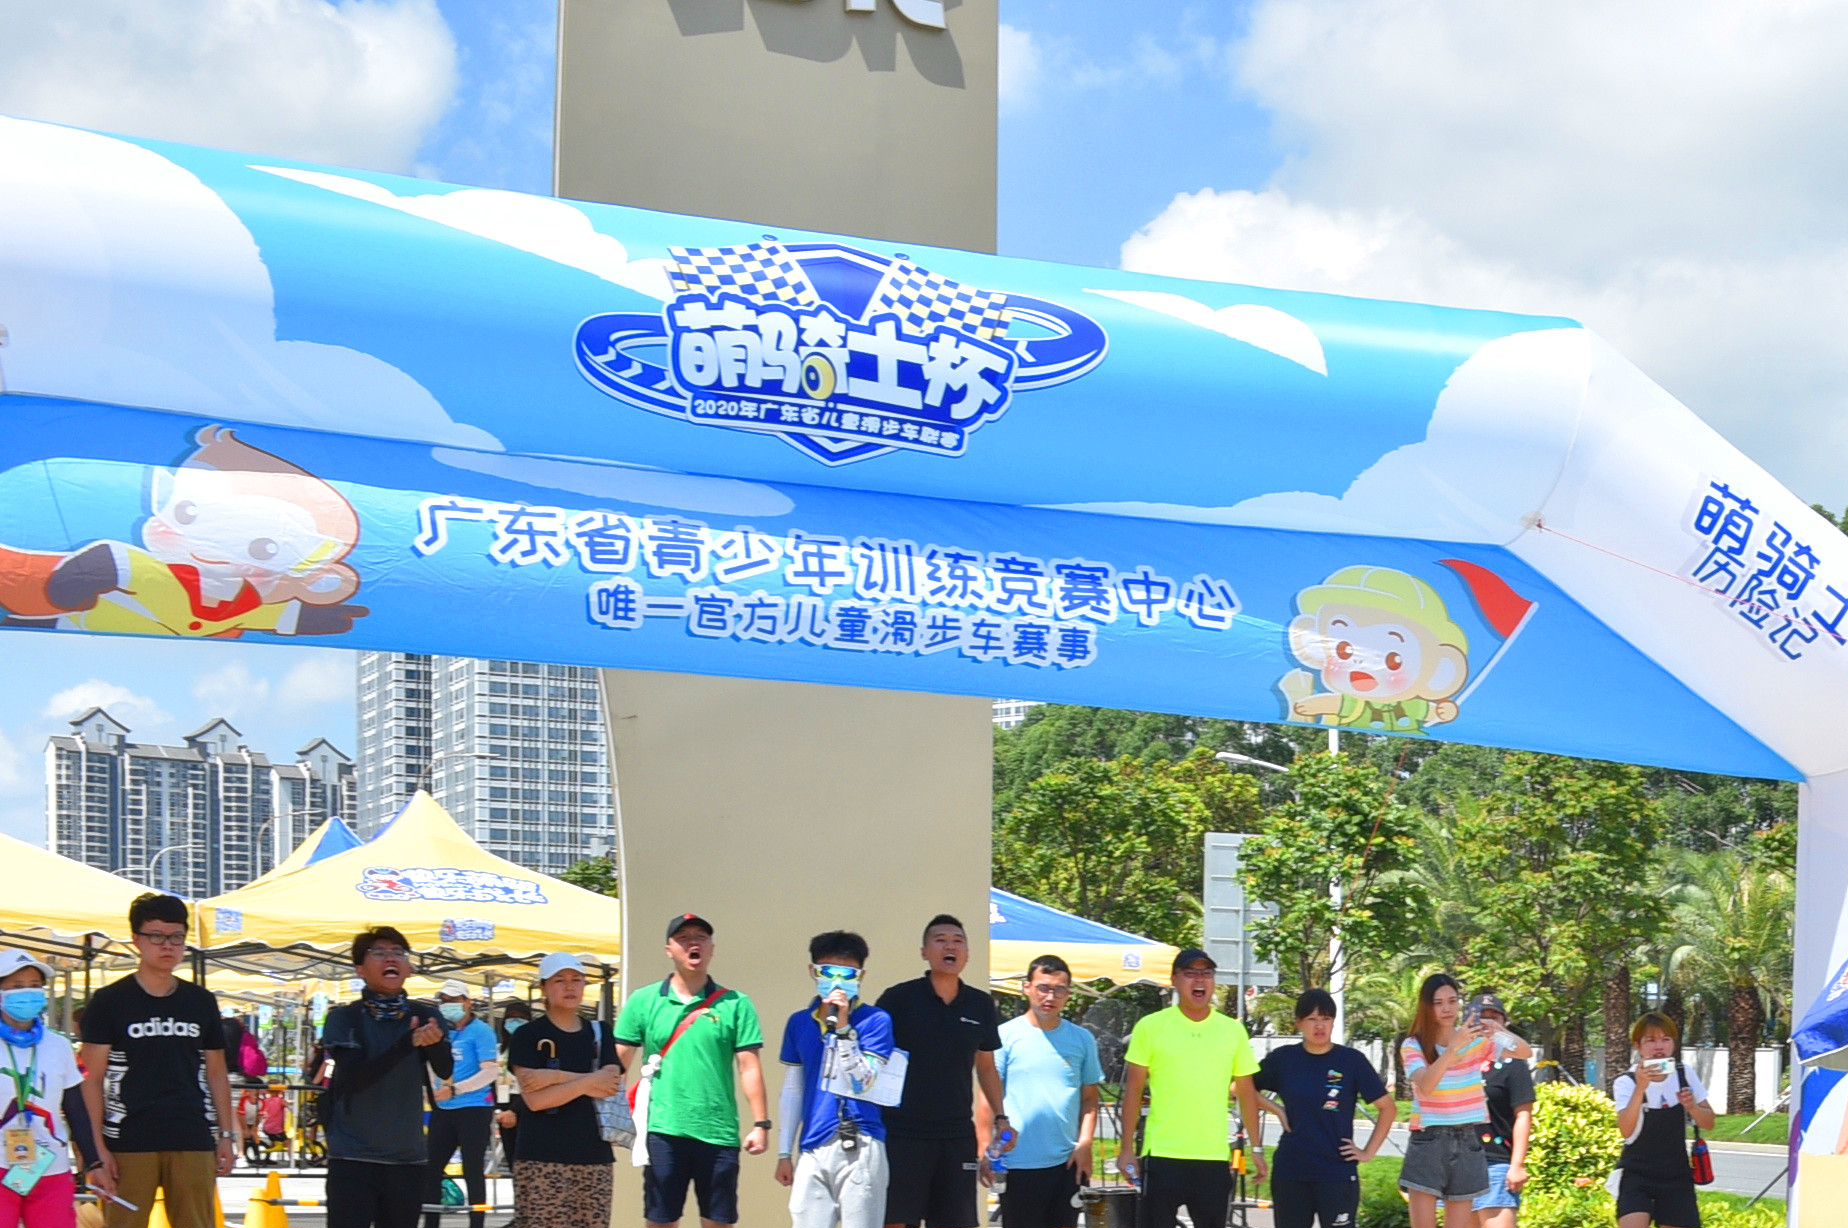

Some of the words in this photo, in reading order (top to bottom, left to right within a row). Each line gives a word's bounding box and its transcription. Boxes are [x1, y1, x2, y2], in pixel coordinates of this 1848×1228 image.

[674, 300, 1010, 418] 萌骑士杯
[417, 496, 1242, 630] 广东省青少年训练竞赛中心
[1692, 547, 1819, 660] 历险记
[590, 581, 1098, 668] 唯一官方儿童滑步车赛事
[127, 1017, 201, 1038] adidas
